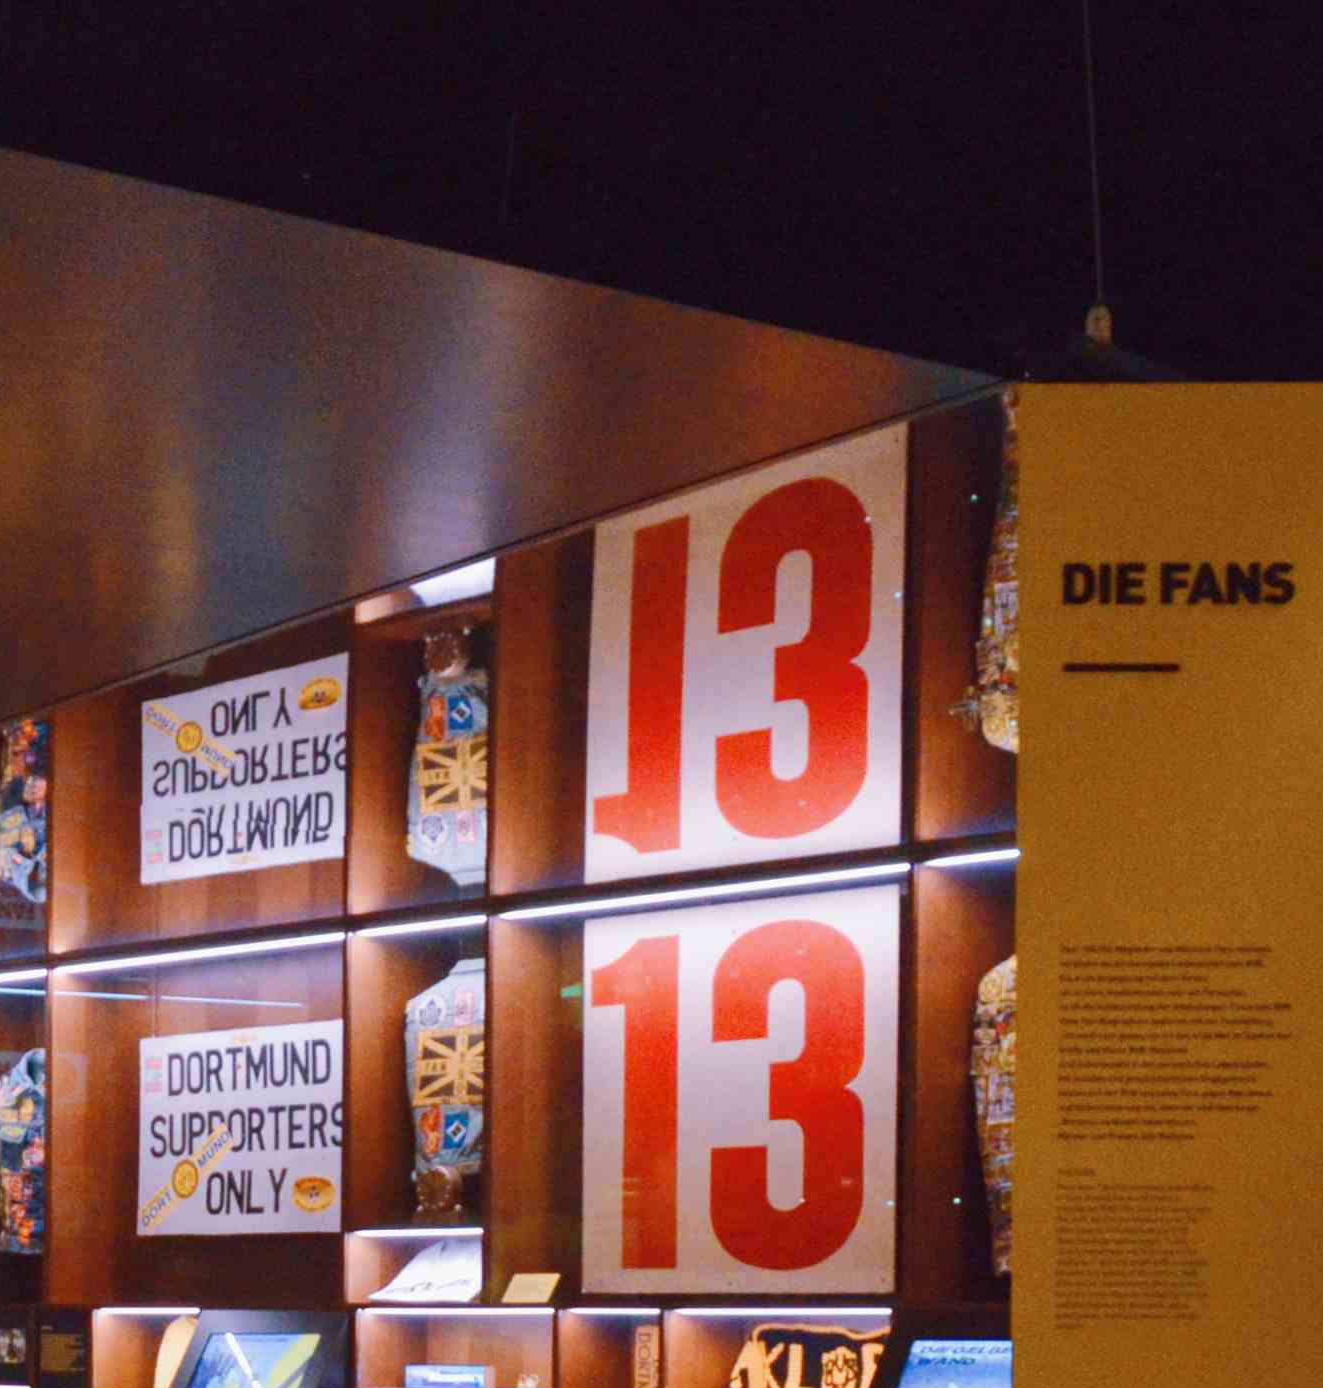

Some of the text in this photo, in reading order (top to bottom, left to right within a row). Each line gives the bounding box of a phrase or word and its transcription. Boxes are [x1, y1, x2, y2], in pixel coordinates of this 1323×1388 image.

[1062, 561, 1296, 606] DIE FANS
[168, 1039, 331, 1096] DORTMUND
[591, 919, 865, 1271] 13
[207, 1168, 287, 1215] ONLY
